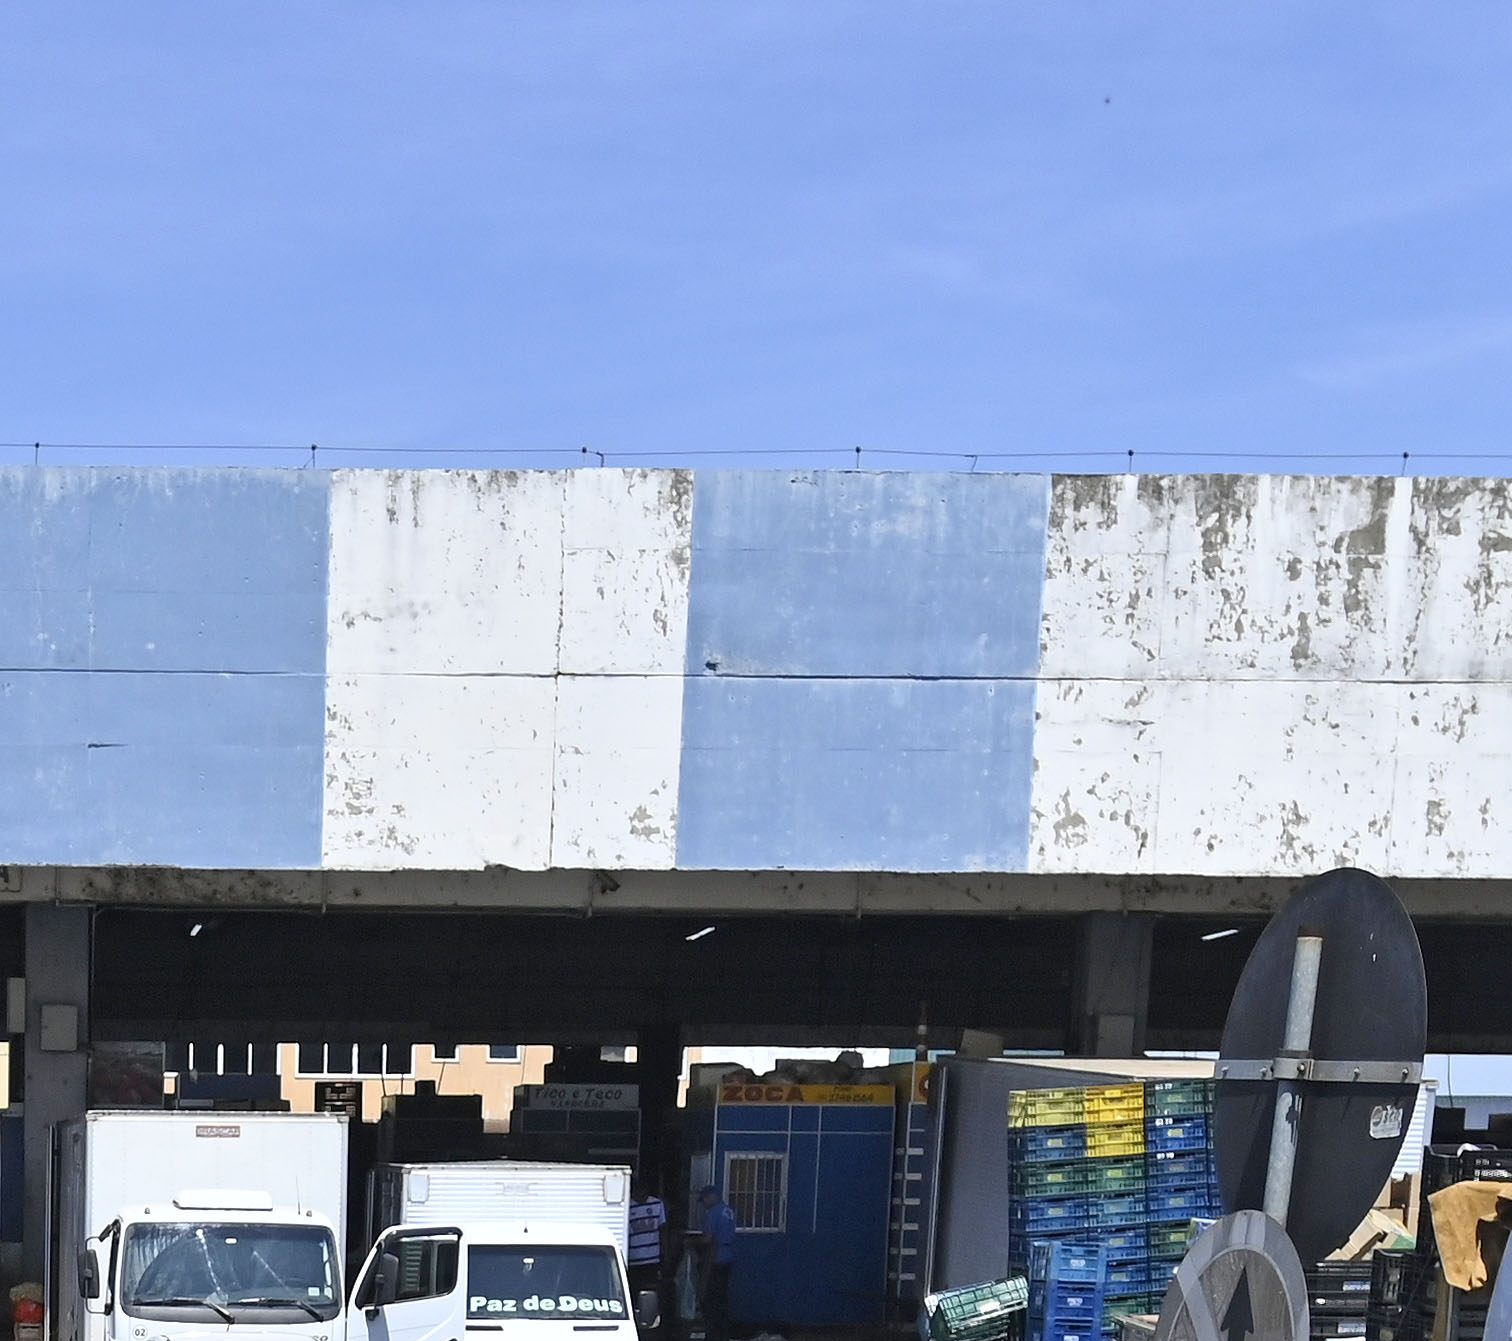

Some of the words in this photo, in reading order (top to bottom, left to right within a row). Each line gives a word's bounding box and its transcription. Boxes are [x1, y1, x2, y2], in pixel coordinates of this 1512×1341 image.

[723, 1086, 805, 1101] ZOCA
[470, 1296, 517, 1312] Paz
[523, 1295, 555, 1311] de
[557, 1295, 623, 1313] Deus
[134, 1328, 146, 1336] 02
